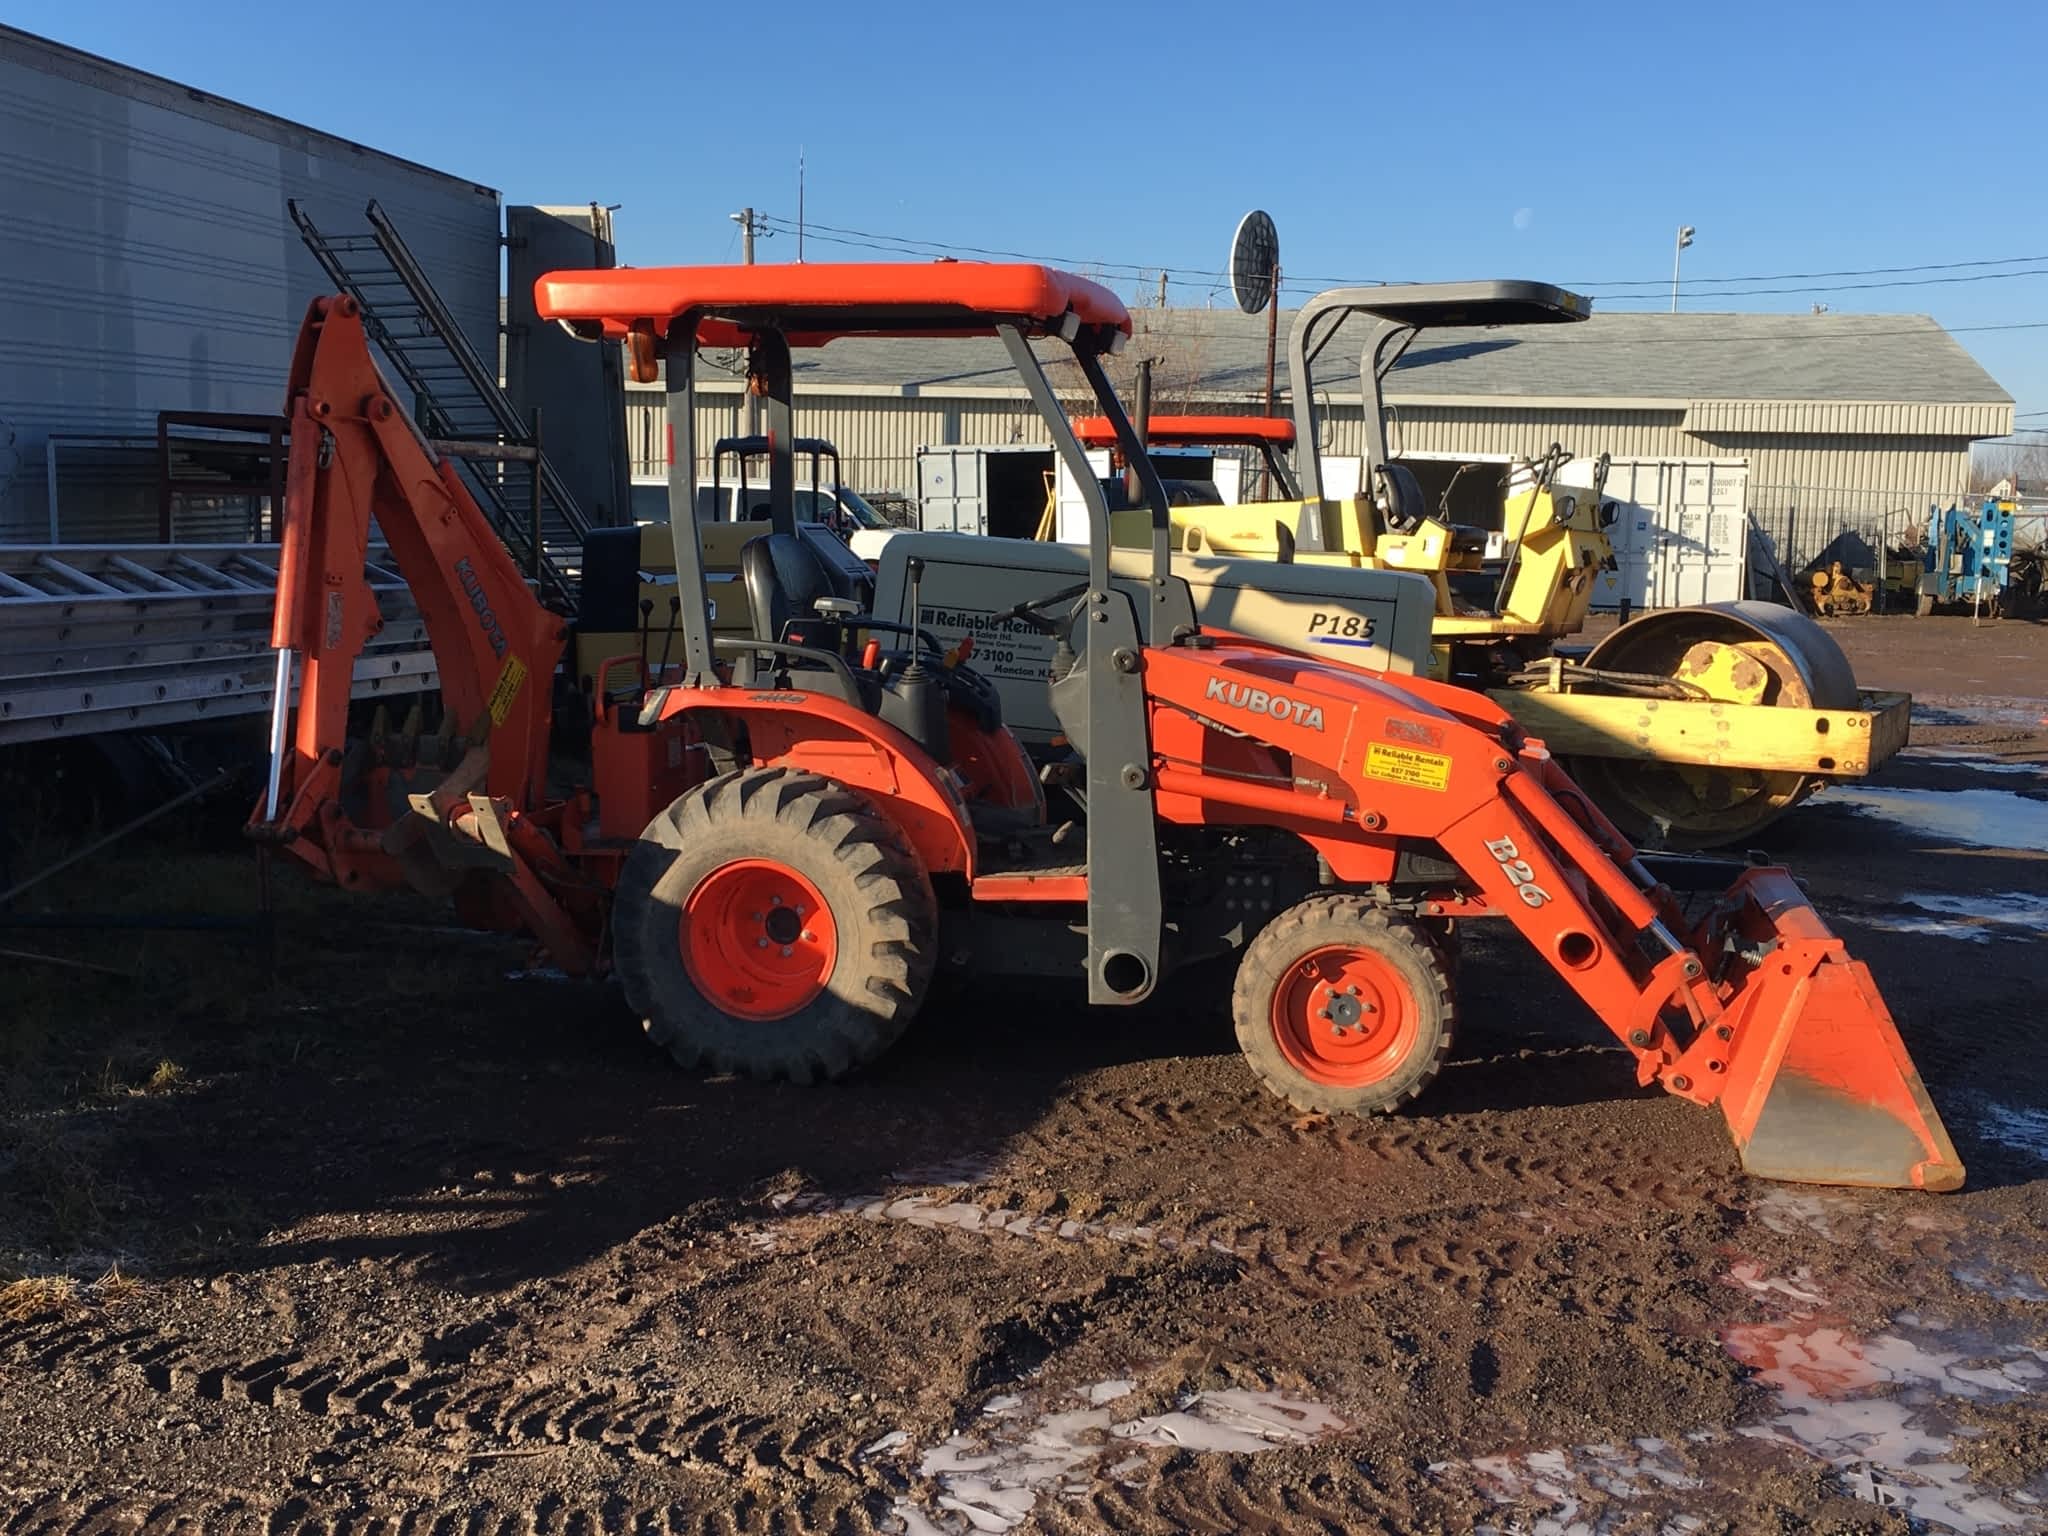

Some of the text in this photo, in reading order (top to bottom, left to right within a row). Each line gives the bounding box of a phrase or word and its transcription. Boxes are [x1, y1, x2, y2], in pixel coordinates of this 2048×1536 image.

[455, 556, 507, 658] KUBOTA
[936, 611, 999, 631] Reliable
[1309, 613, 1376, 638] P185
[994, 664, 1034, 676] Moncton
[1205, 676, 1325, 733] KUBOTA
[1382, 748, 1413, 761] Reliable
[1482, 834, 1552, 908] B26
